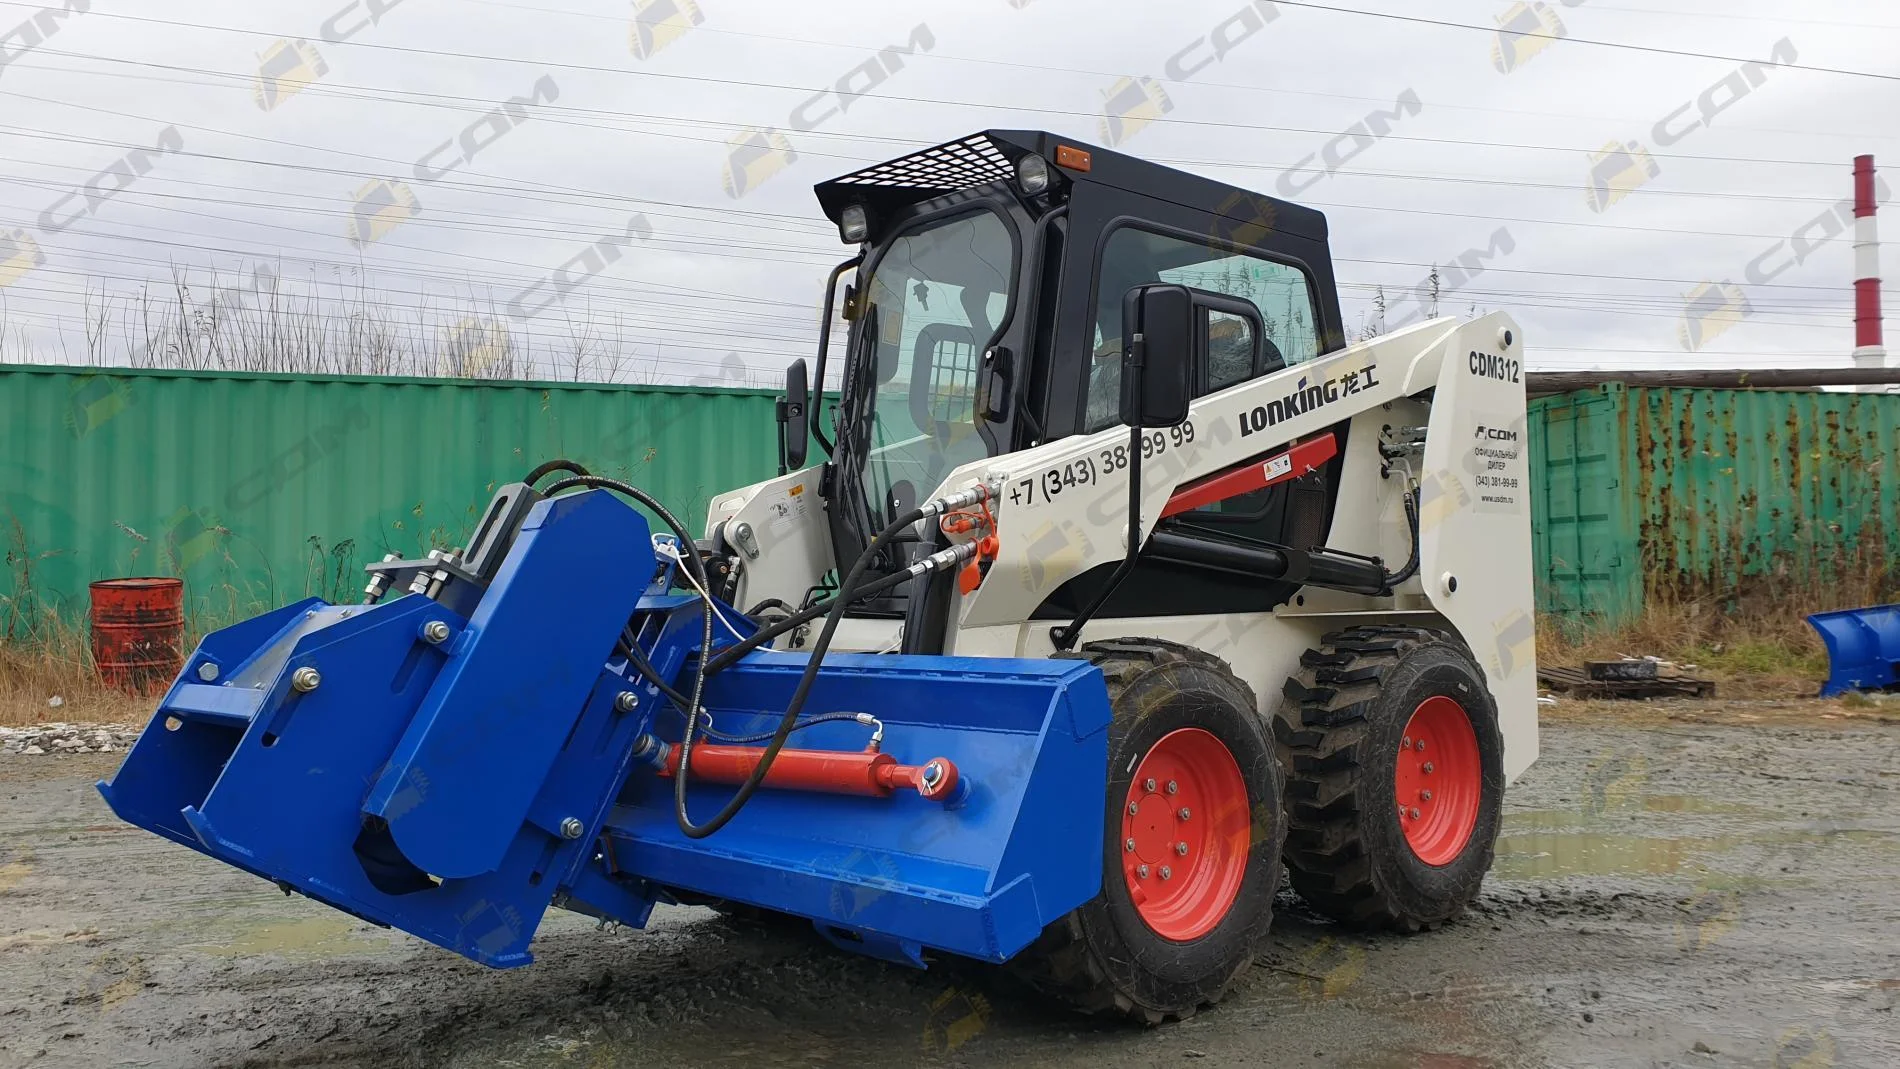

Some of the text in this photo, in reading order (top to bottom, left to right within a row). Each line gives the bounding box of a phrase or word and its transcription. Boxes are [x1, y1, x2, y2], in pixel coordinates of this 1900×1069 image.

[1469, 351, 1519, 383] CDM312
[1475, 448, 1518, 460] ОФИЦИАЛЬНЫЙ
[1010, 420, 1195, 505] +7 (343) 38 99 99
[1487, 460, 1506, 471] ДИЛЕР
[1475, 475, 1518, 489] (343) 381-99-99
